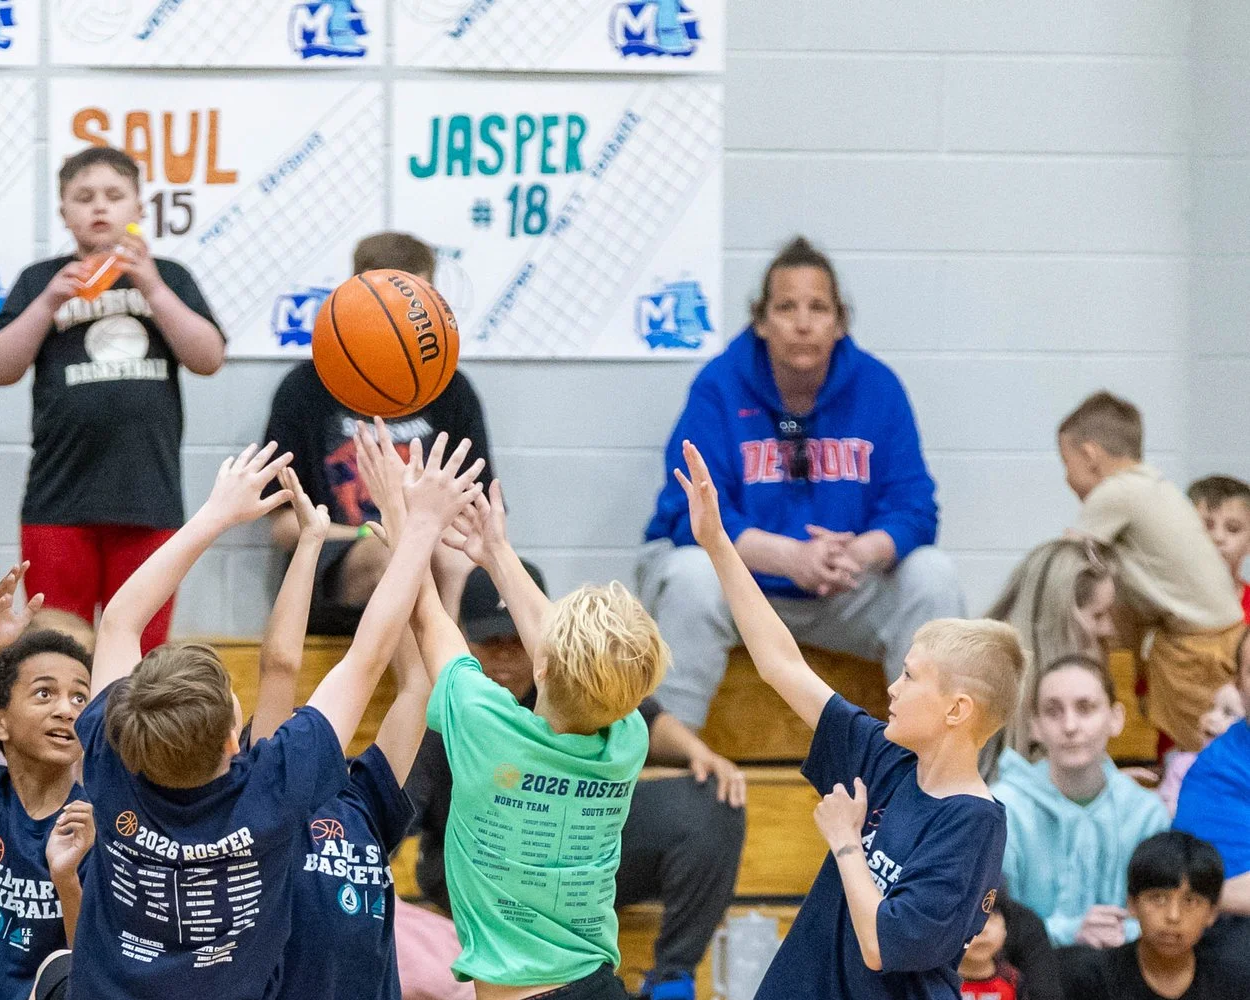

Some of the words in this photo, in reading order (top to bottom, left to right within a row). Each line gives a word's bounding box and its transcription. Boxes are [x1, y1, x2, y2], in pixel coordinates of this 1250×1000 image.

[72, 108, 237, 184] SAUL
[410, 114, 589, 179] JASPER
[387, 276, 440, 365] Wilson
[521, 773, 570, 796] 2026
[494, 795, 523, 809] NORTH
[526, 802, 550, 813] TEAM
[581, 807, 604, 817] SOUTH
[134, 825, 180, 860] 2026
[181, 826, 255, 861] ROSTER
[365, 844, 381, 864] S
